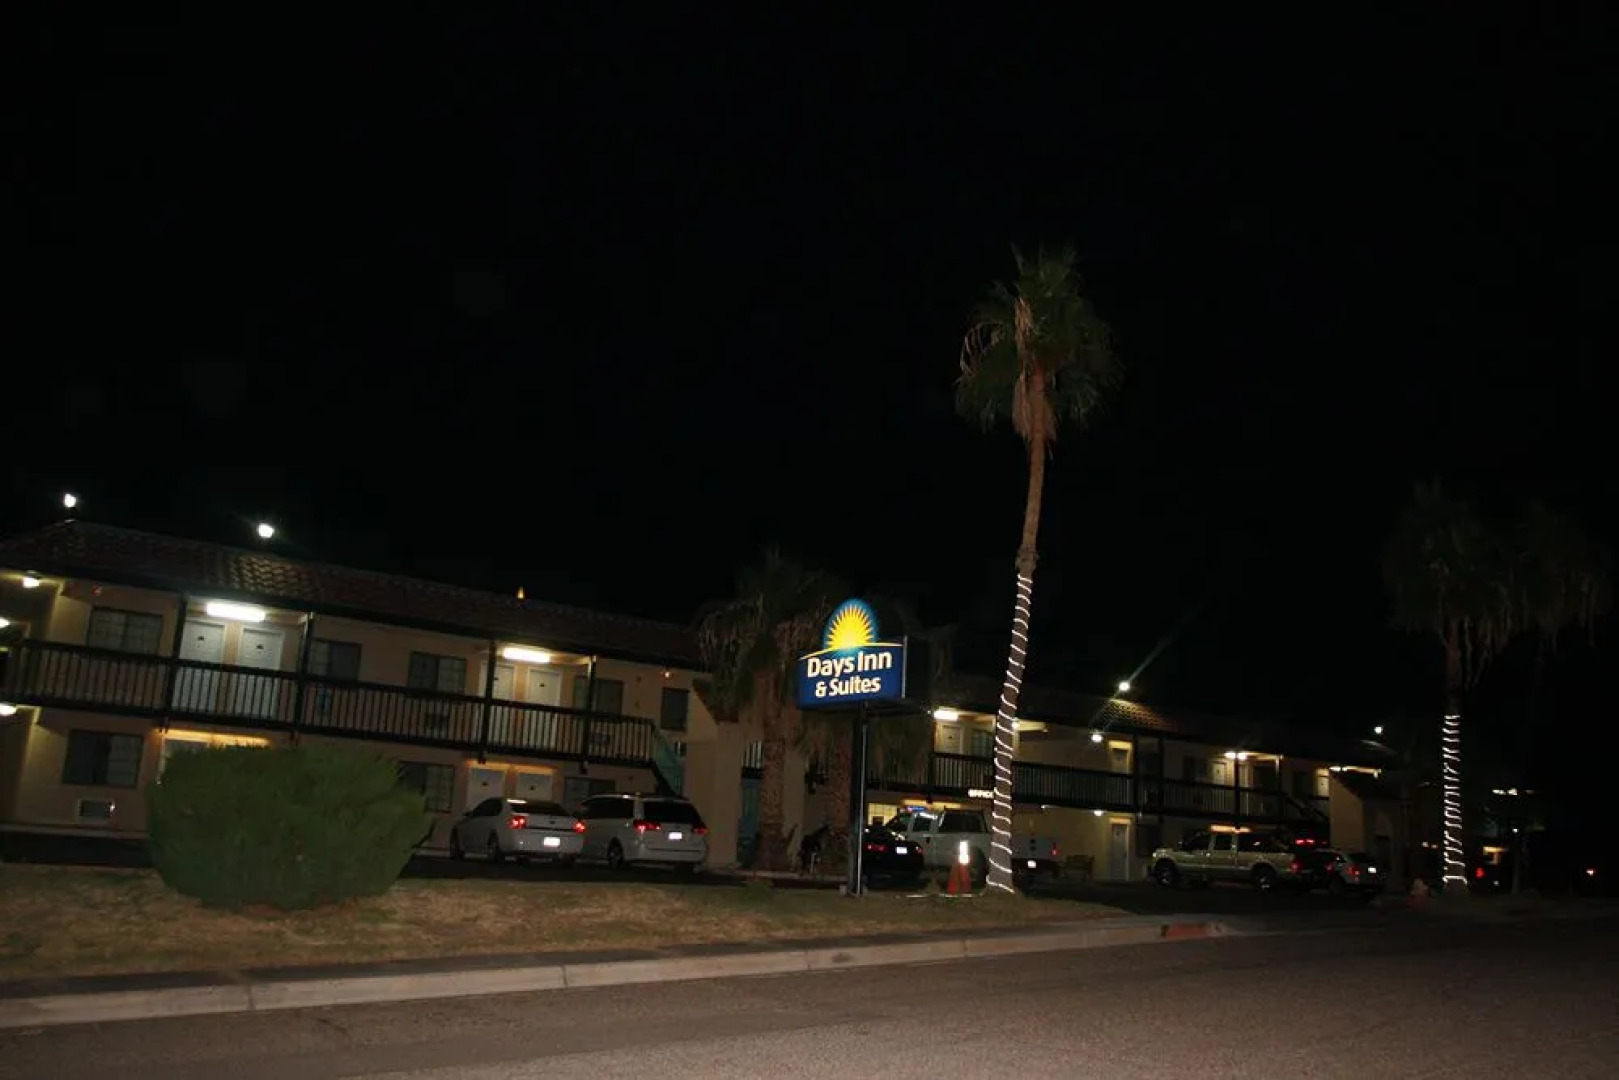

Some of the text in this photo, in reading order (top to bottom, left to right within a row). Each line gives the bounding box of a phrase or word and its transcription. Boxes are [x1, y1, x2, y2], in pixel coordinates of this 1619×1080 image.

[807, 651, 893, 677] Days Inn
[815, 676, 882, 698] & Suites
